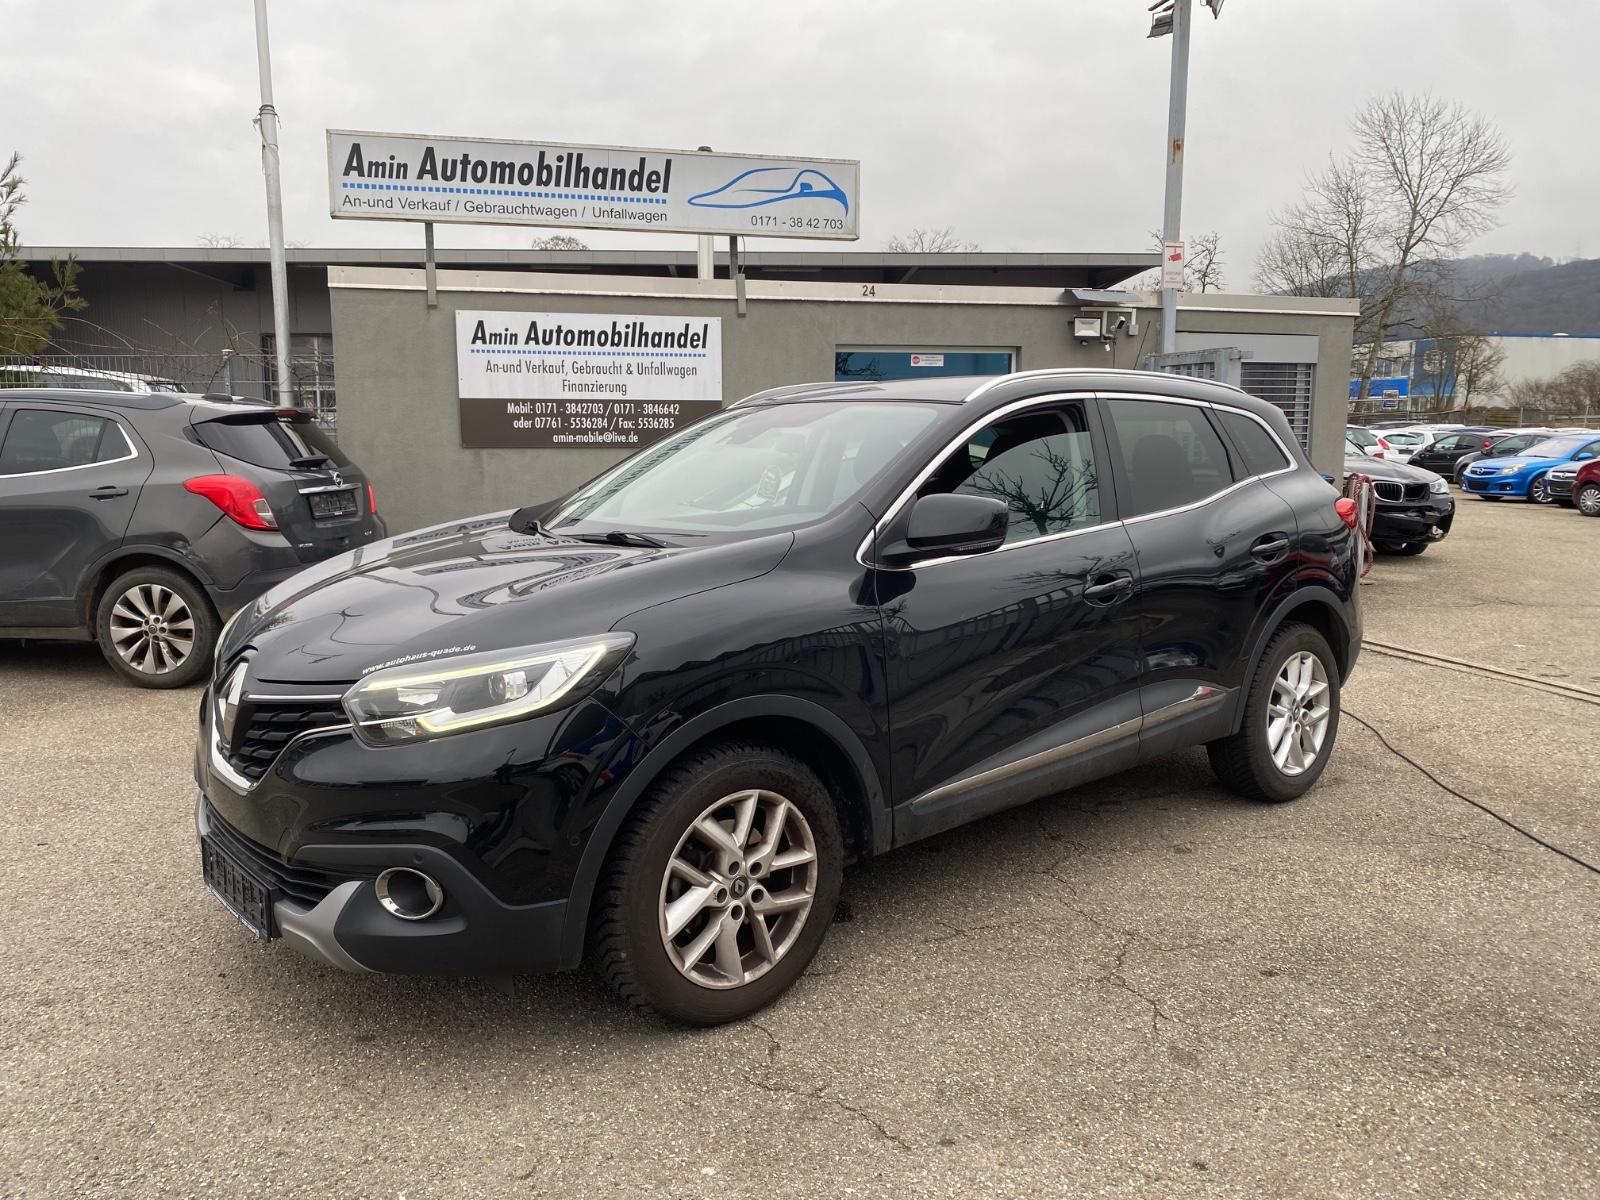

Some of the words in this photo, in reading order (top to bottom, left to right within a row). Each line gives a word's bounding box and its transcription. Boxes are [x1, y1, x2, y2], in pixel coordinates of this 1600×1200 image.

[342, 143, 408, 180] Amin
[416, 146, 672, 194] Automobilhandel
[342, 194, 393, 208] An-und
[398, 198, 451, 212] Verkauf
[455, 200, 460, 212] /
[464, 200, 578, 219] Gebrauchtwagen
[582, 206, 586, 218] /
[592, 206, 668, 223] Unfallwagen
[751, 216, 777, 226] 0171
[790, 217, 803, 228] 38
[806, 218, 820, 228] 42
[824, 218, 844, 230] 703
[862, 284, 876, 296] 24
[471, 320, 518, 346] Amin
[524, 320, 708, 348] Automobilhandel
[486, 360, 522, 374] An-und
[525, 360, 568, 376] Verkauf,
[572, 360, 622, 375] Gebraucht
[626, 362, 634, 375] &
[637, 361, 698, 379] Unfallwagen
[562, 380, 627, 396] Finanzierung
[507, 402, 534, 414] Mobil:
[536, 402, 557, 414] 0171
[566, 403, 604, 414] 3842703
[605, 402, 612, 416] /
[614, 404, 634, 414] 0171
[642, 404, 680, 414] 3846642
[513, 417, 532, 428] oder
[534, 417, 562, 428] 07761
[570, 418, 608, 428] 5536284
[610, 417, 617, 431] /
[618, 418, 636, 428] Fax:
[638, 418, 675, 428] 5536285
[552, 431, 638, 442] amin-mobile@live.de
[362, 644, 476, 674] www.autohaus-quade.de
